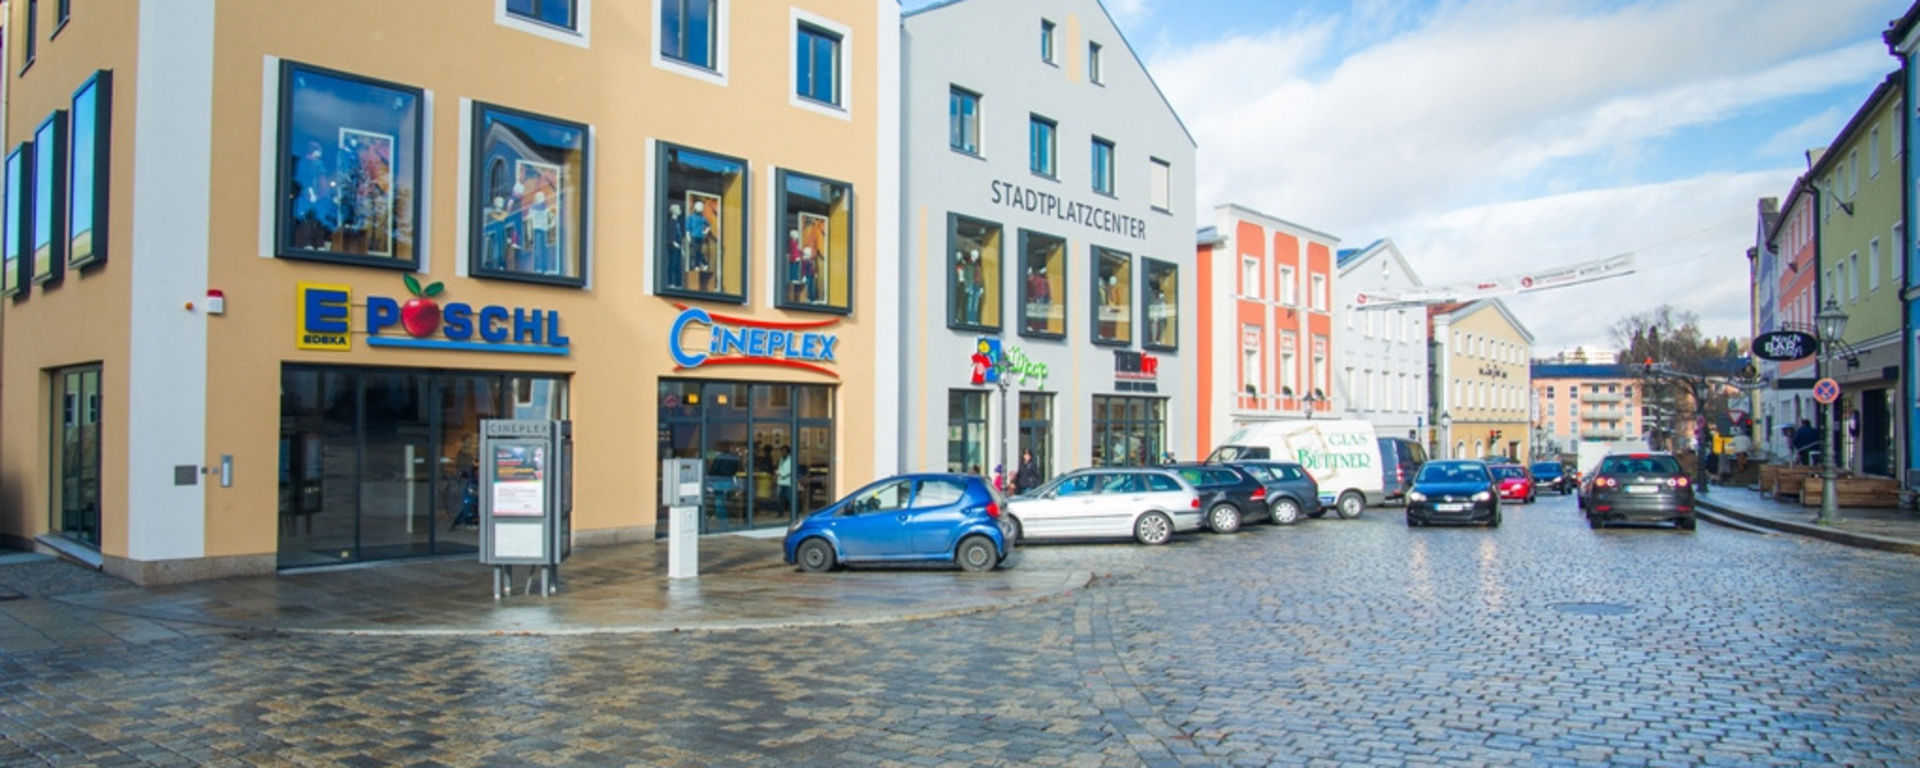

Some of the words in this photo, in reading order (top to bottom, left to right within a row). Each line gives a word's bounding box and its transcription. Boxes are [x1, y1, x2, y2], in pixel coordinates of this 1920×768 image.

[991, 179, 1146, 239] STADTPLATZCENTER
[304, 335, 347, 346] EDEKA
[490, 423, 548, 434] CINEPLEX
[1329, 432, 1368, 446] GLAS
